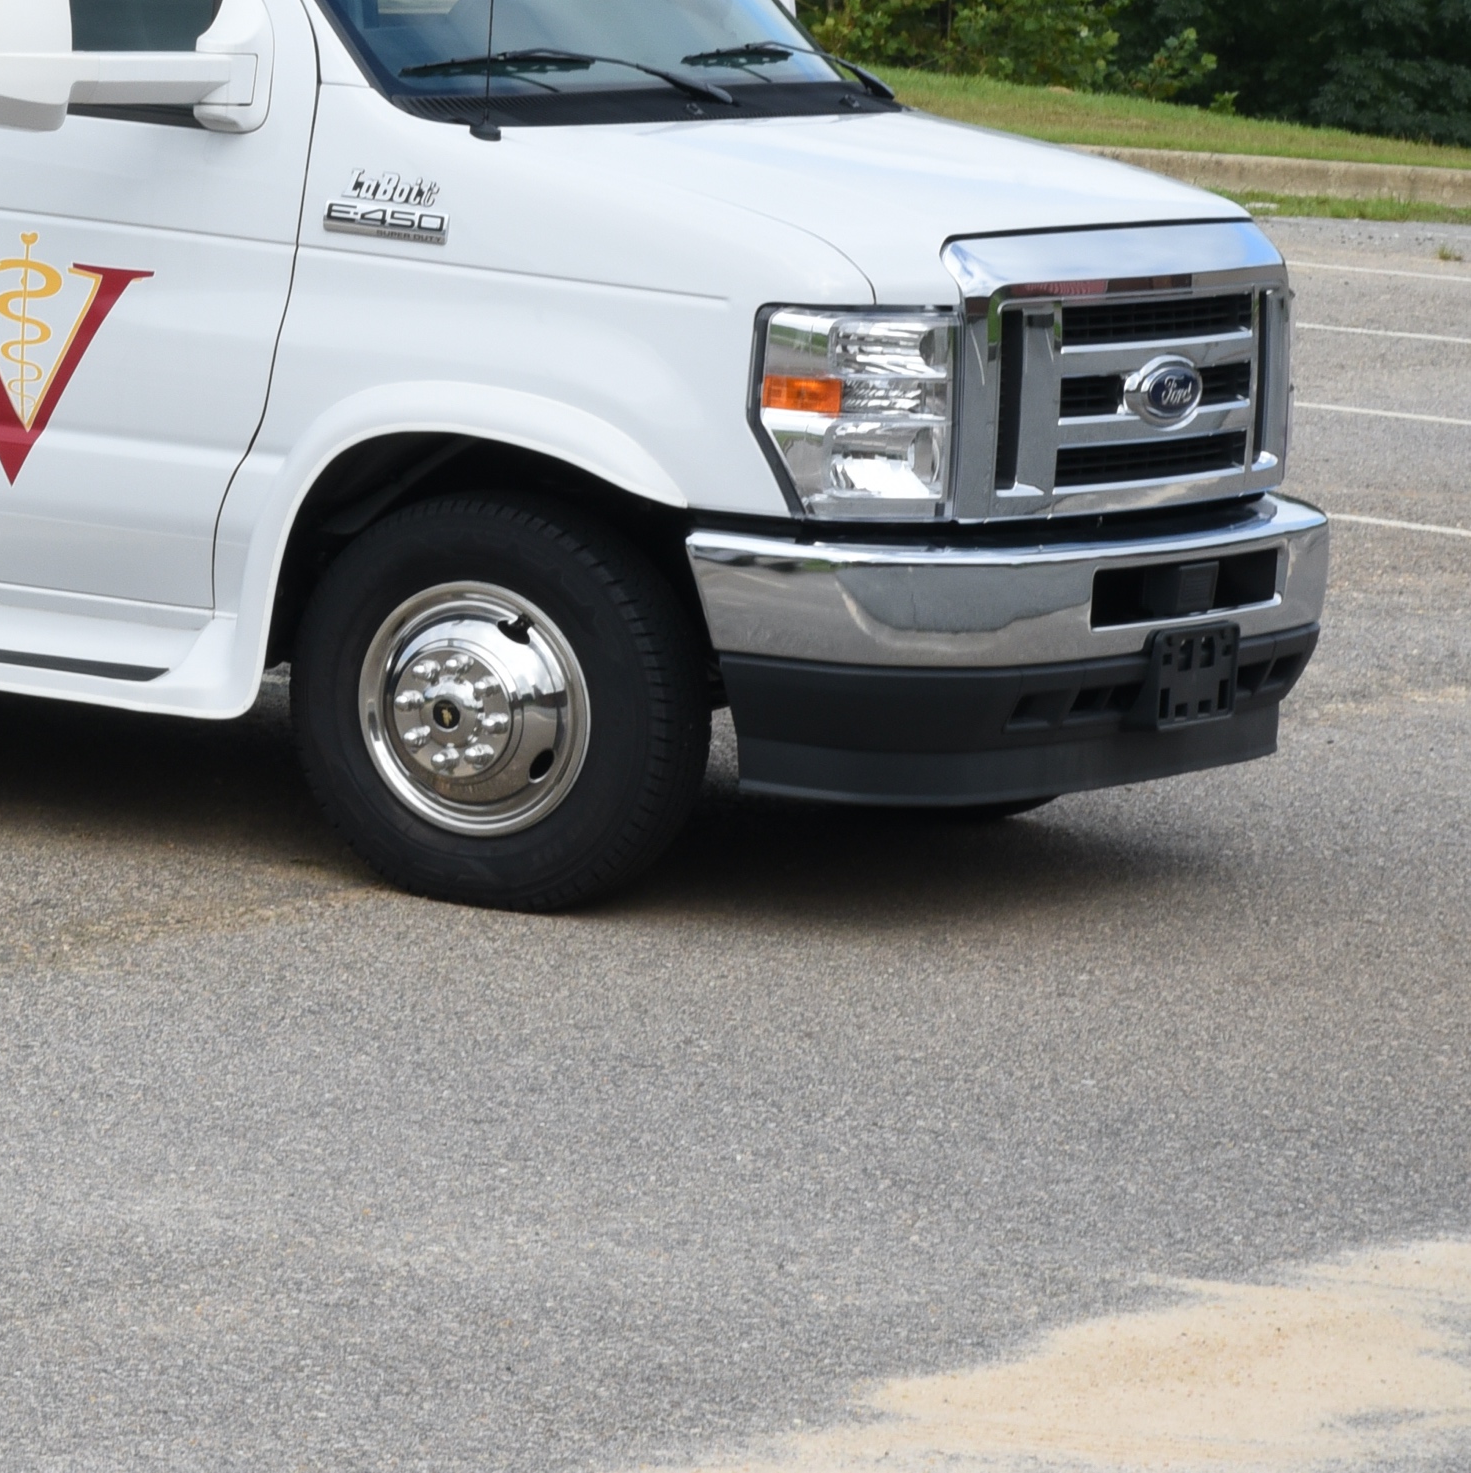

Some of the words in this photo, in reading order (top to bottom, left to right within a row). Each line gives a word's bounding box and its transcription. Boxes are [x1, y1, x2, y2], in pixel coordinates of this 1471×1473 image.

[376, 229, 411, 239] SUPER
[413, 231, 444, 243] DUTY
[1161, 375, 1193, 406] Ford
